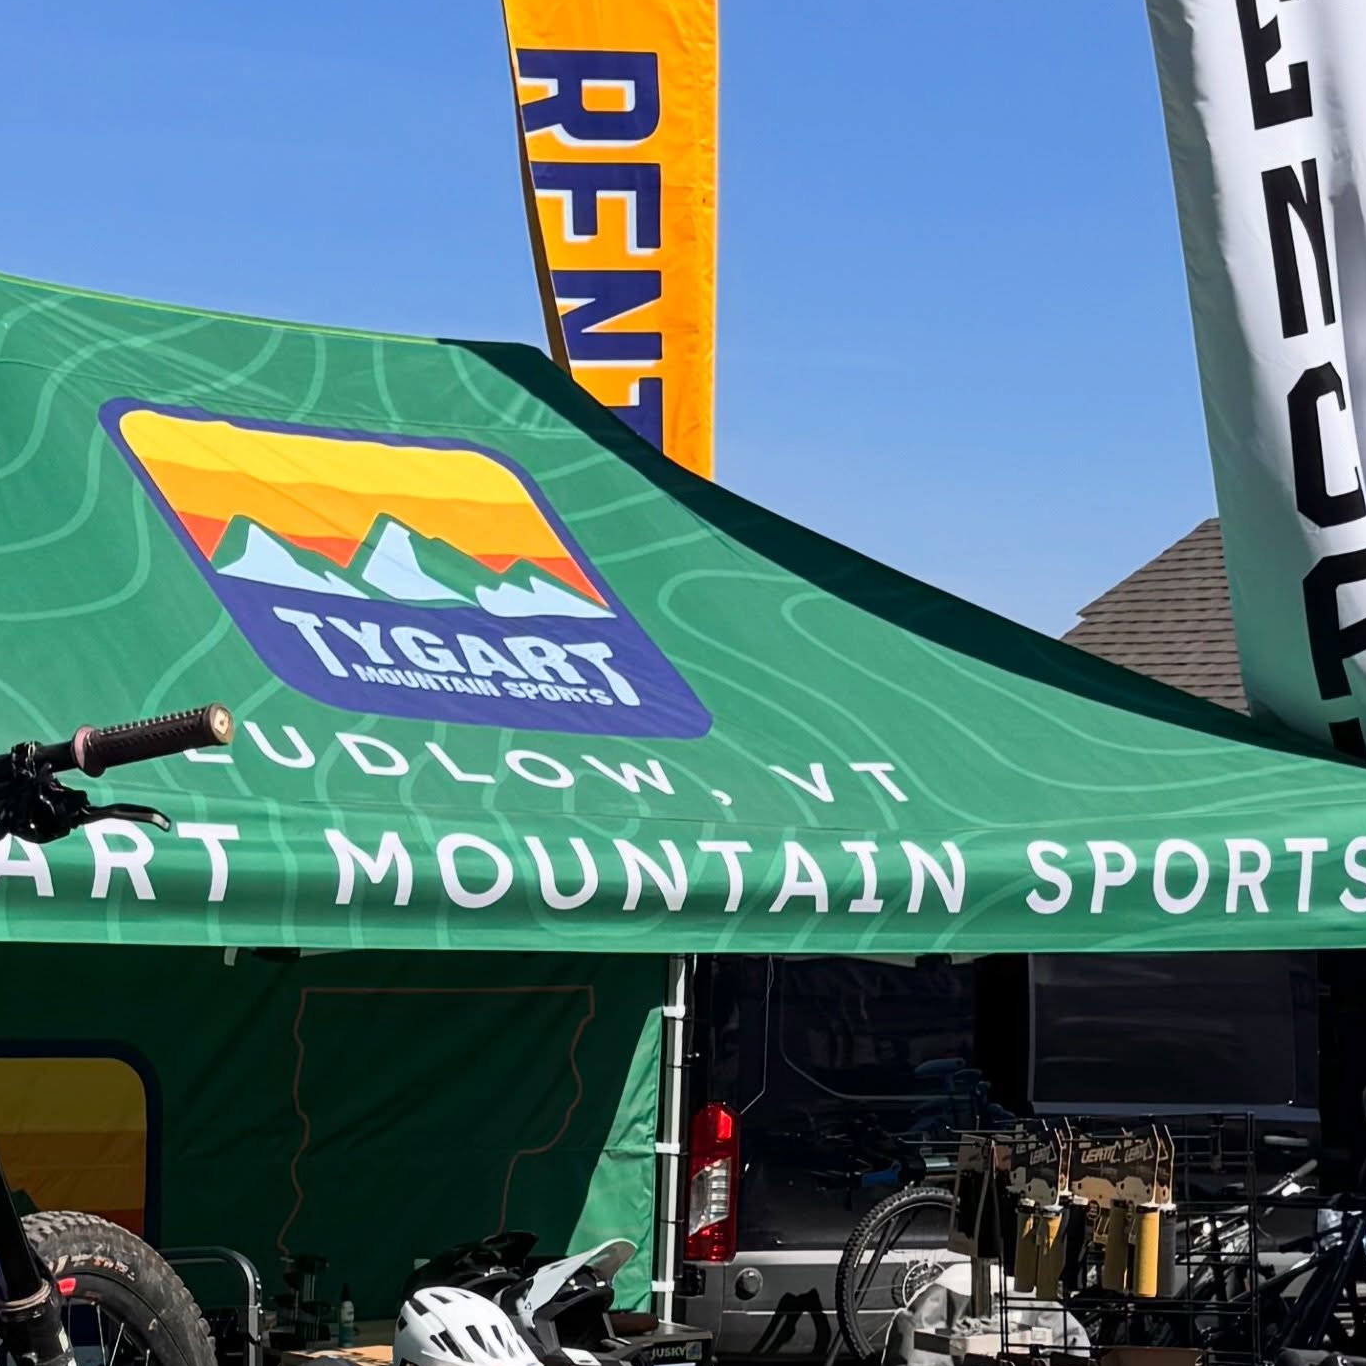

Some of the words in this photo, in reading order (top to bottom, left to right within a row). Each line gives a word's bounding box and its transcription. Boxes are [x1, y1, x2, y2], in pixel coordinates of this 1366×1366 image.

[272, 605, 641, 707] TYGART
[352, 662, 501, 700] MOUNTAIN
[504, 678, 614, 707] SPORTS
[769, 761, 909, 804] VT
[324, 827, 966, 915] MOUNTAIN
